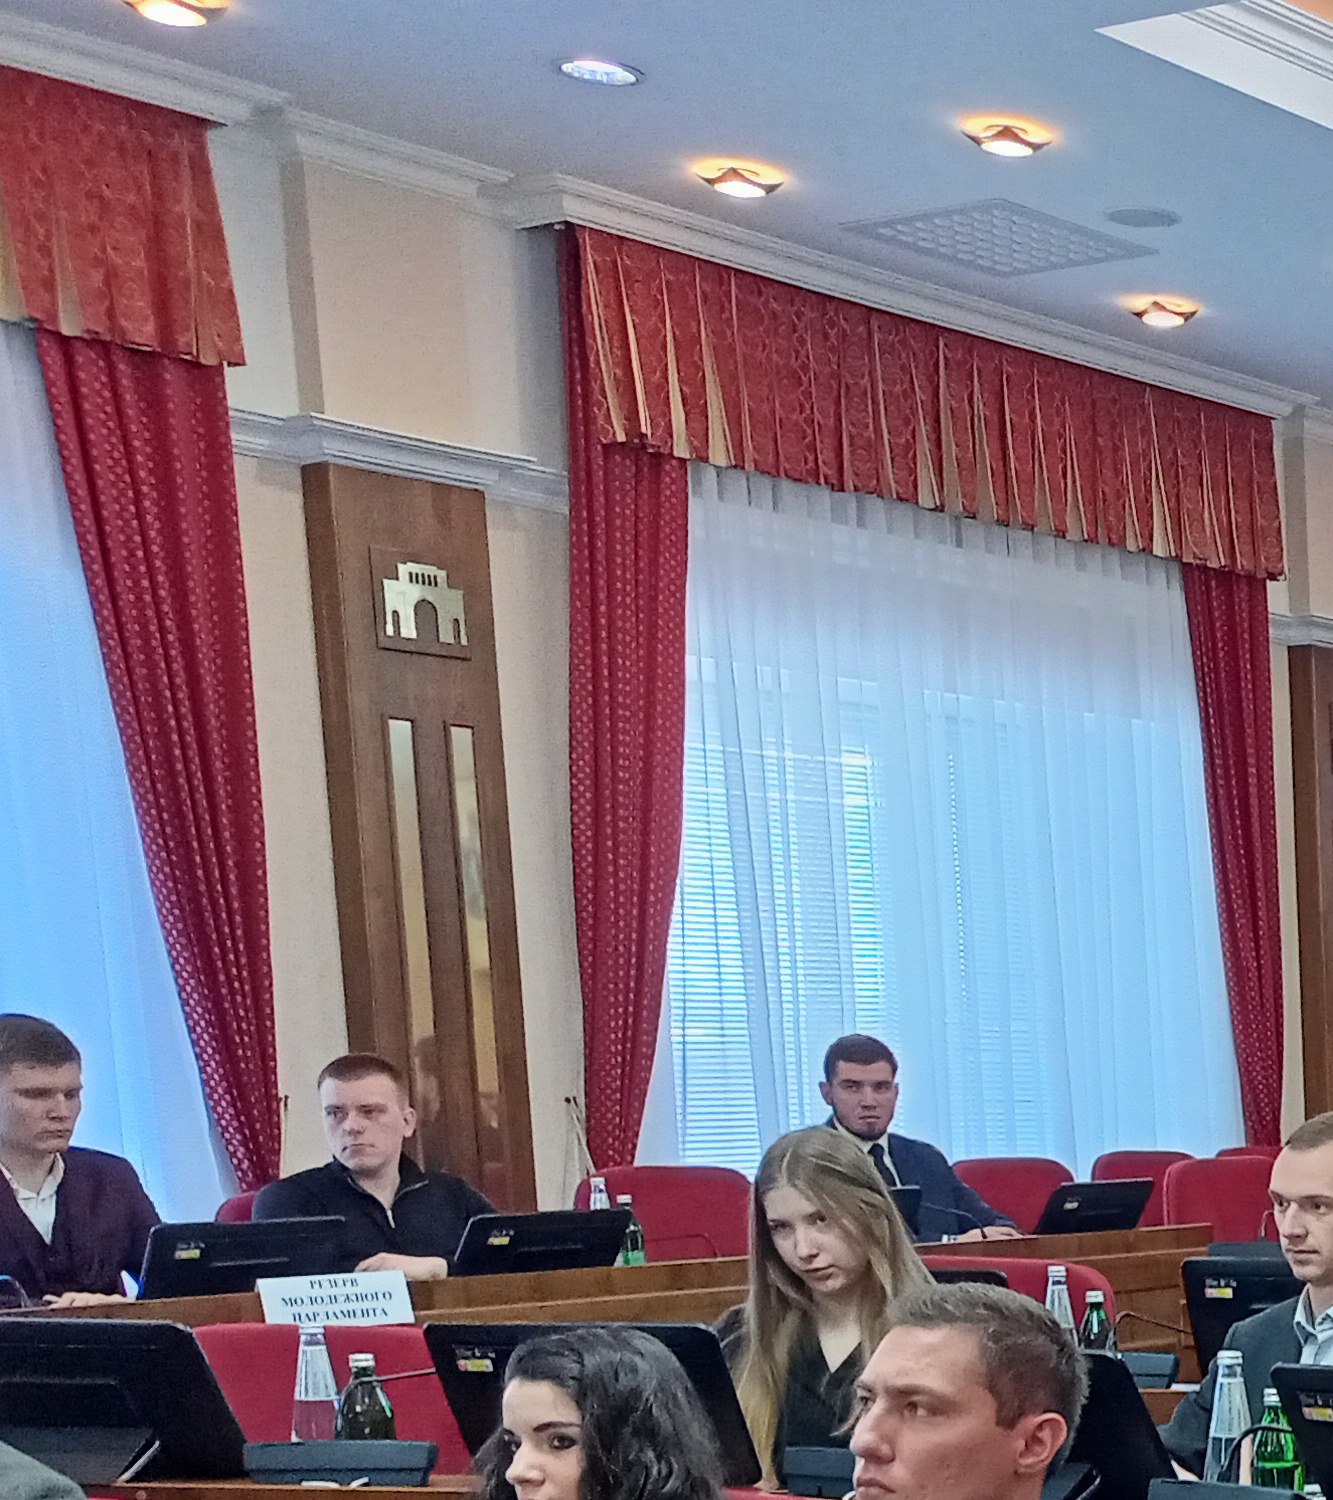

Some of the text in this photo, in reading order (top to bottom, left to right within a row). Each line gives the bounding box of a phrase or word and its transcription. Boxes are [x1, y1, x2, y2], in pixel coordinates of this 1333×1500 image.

[309, 1277, 359, 1290] РЕЗЕРВ
[281, 1290, 393, 1308] МОЛОДЕЖНОГО
[292, 1307, 389, 1324] ПАРЛАМЕНТА
